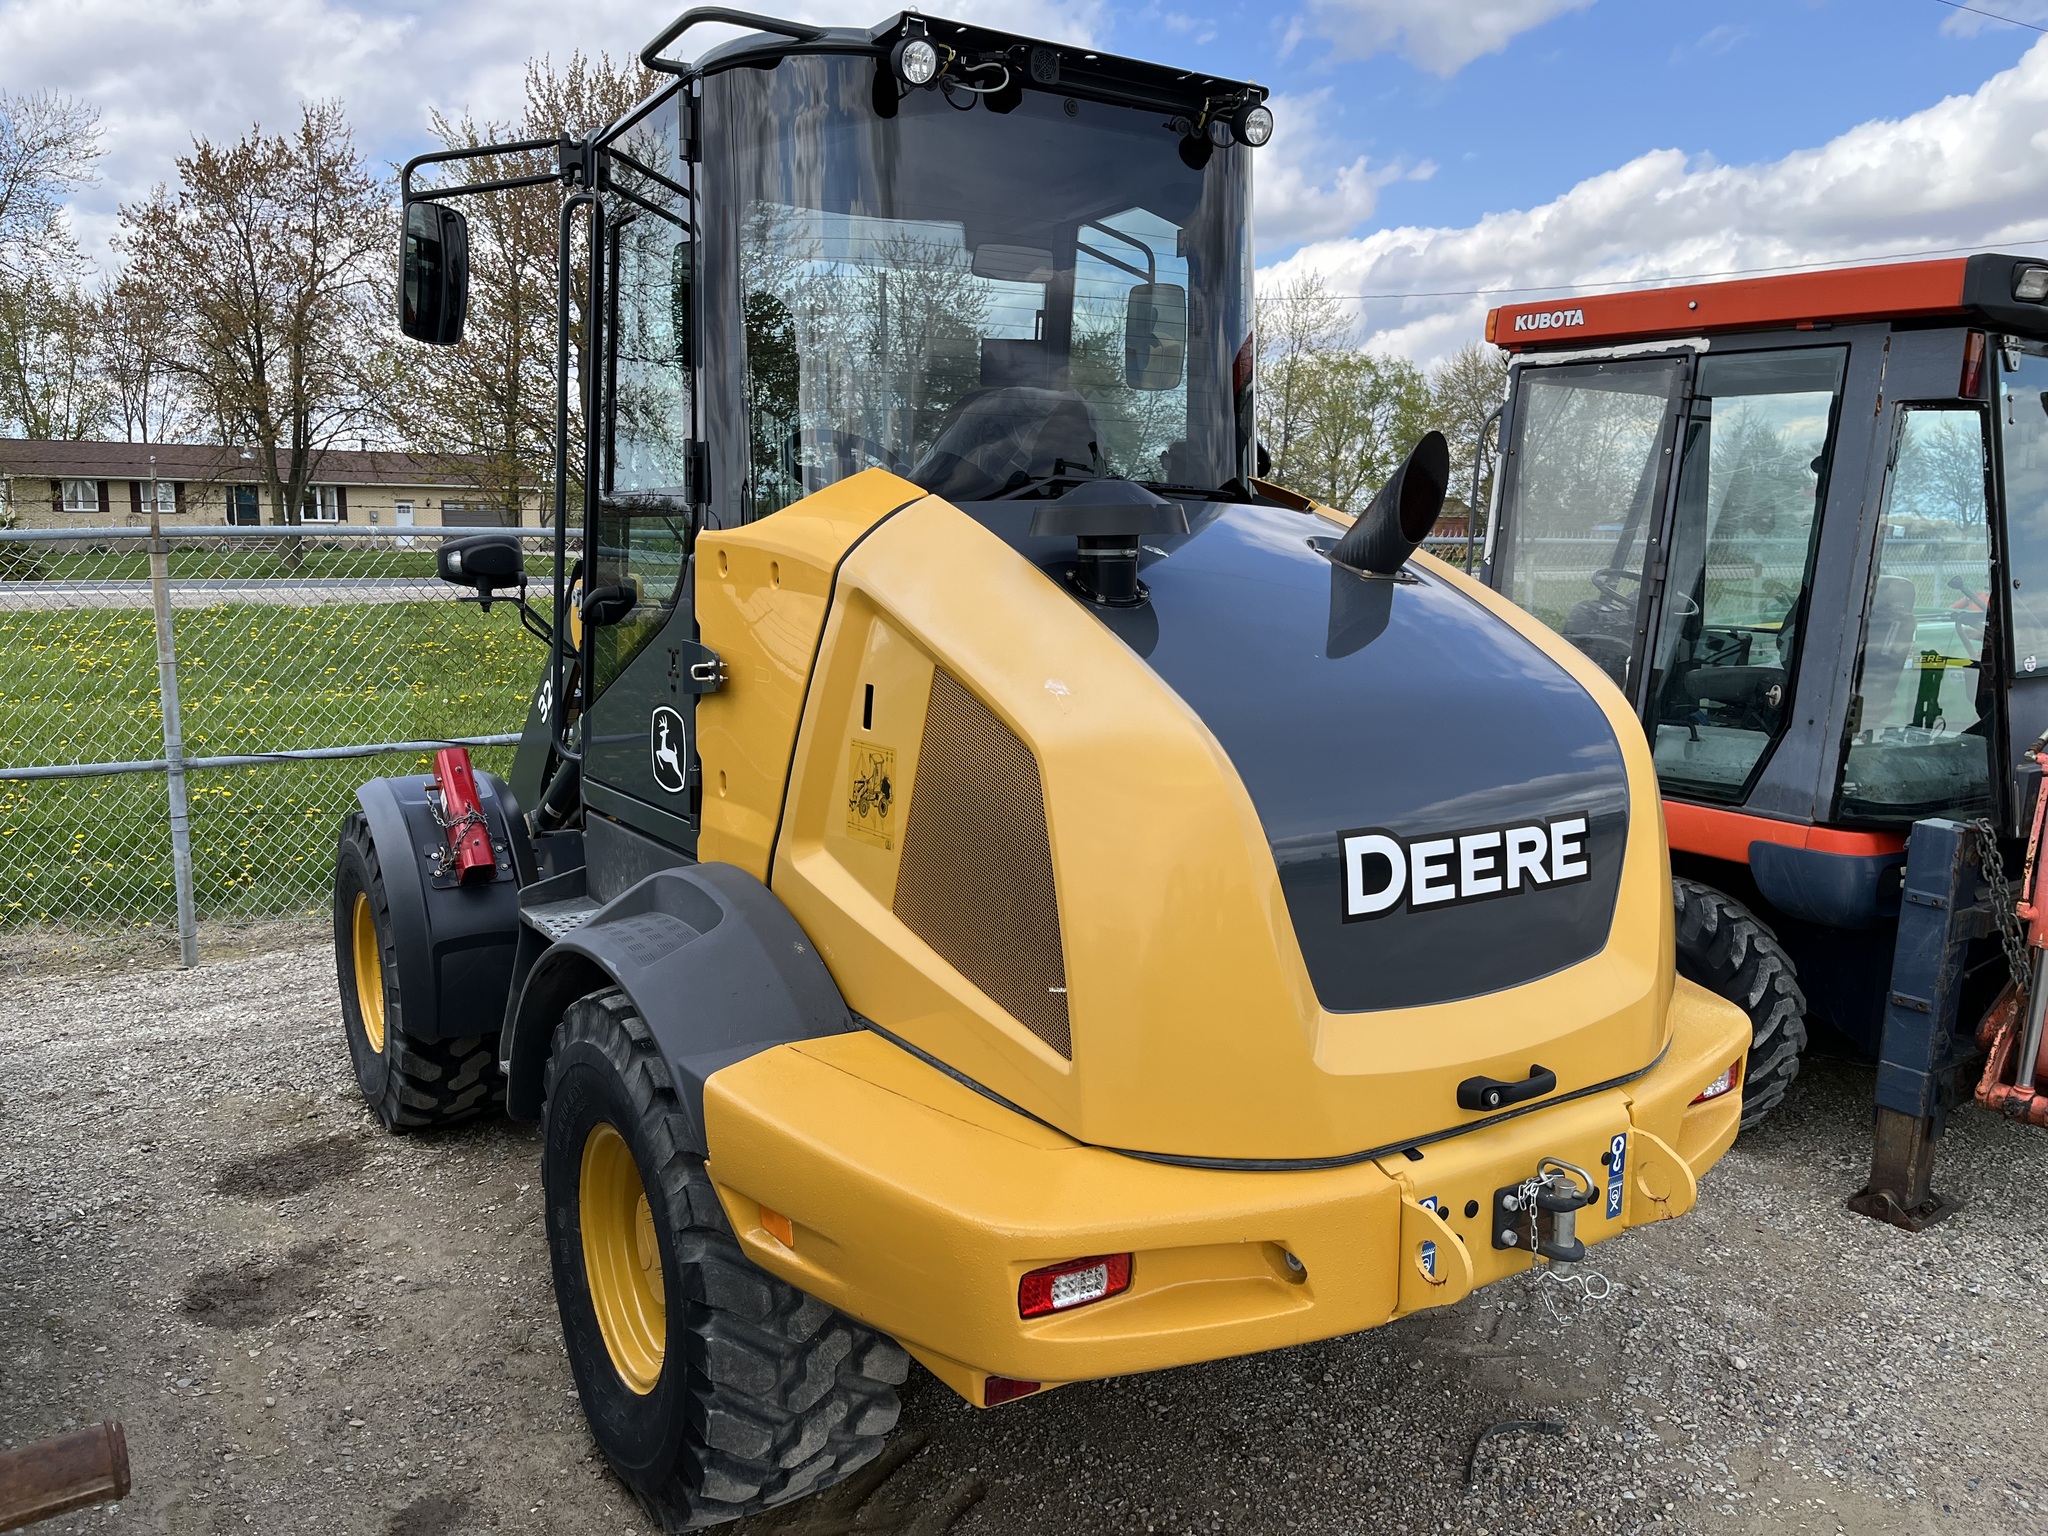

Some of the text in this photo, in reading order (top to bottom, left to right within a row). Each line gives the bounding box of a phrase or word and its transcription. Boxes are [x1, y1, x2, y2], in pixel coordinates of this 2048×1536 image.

[1514, 309, 1585, 332] KUBOTA
[1913, 654, 1943, 664] EERE
[1343, 817, 1588, 916] DEERE
